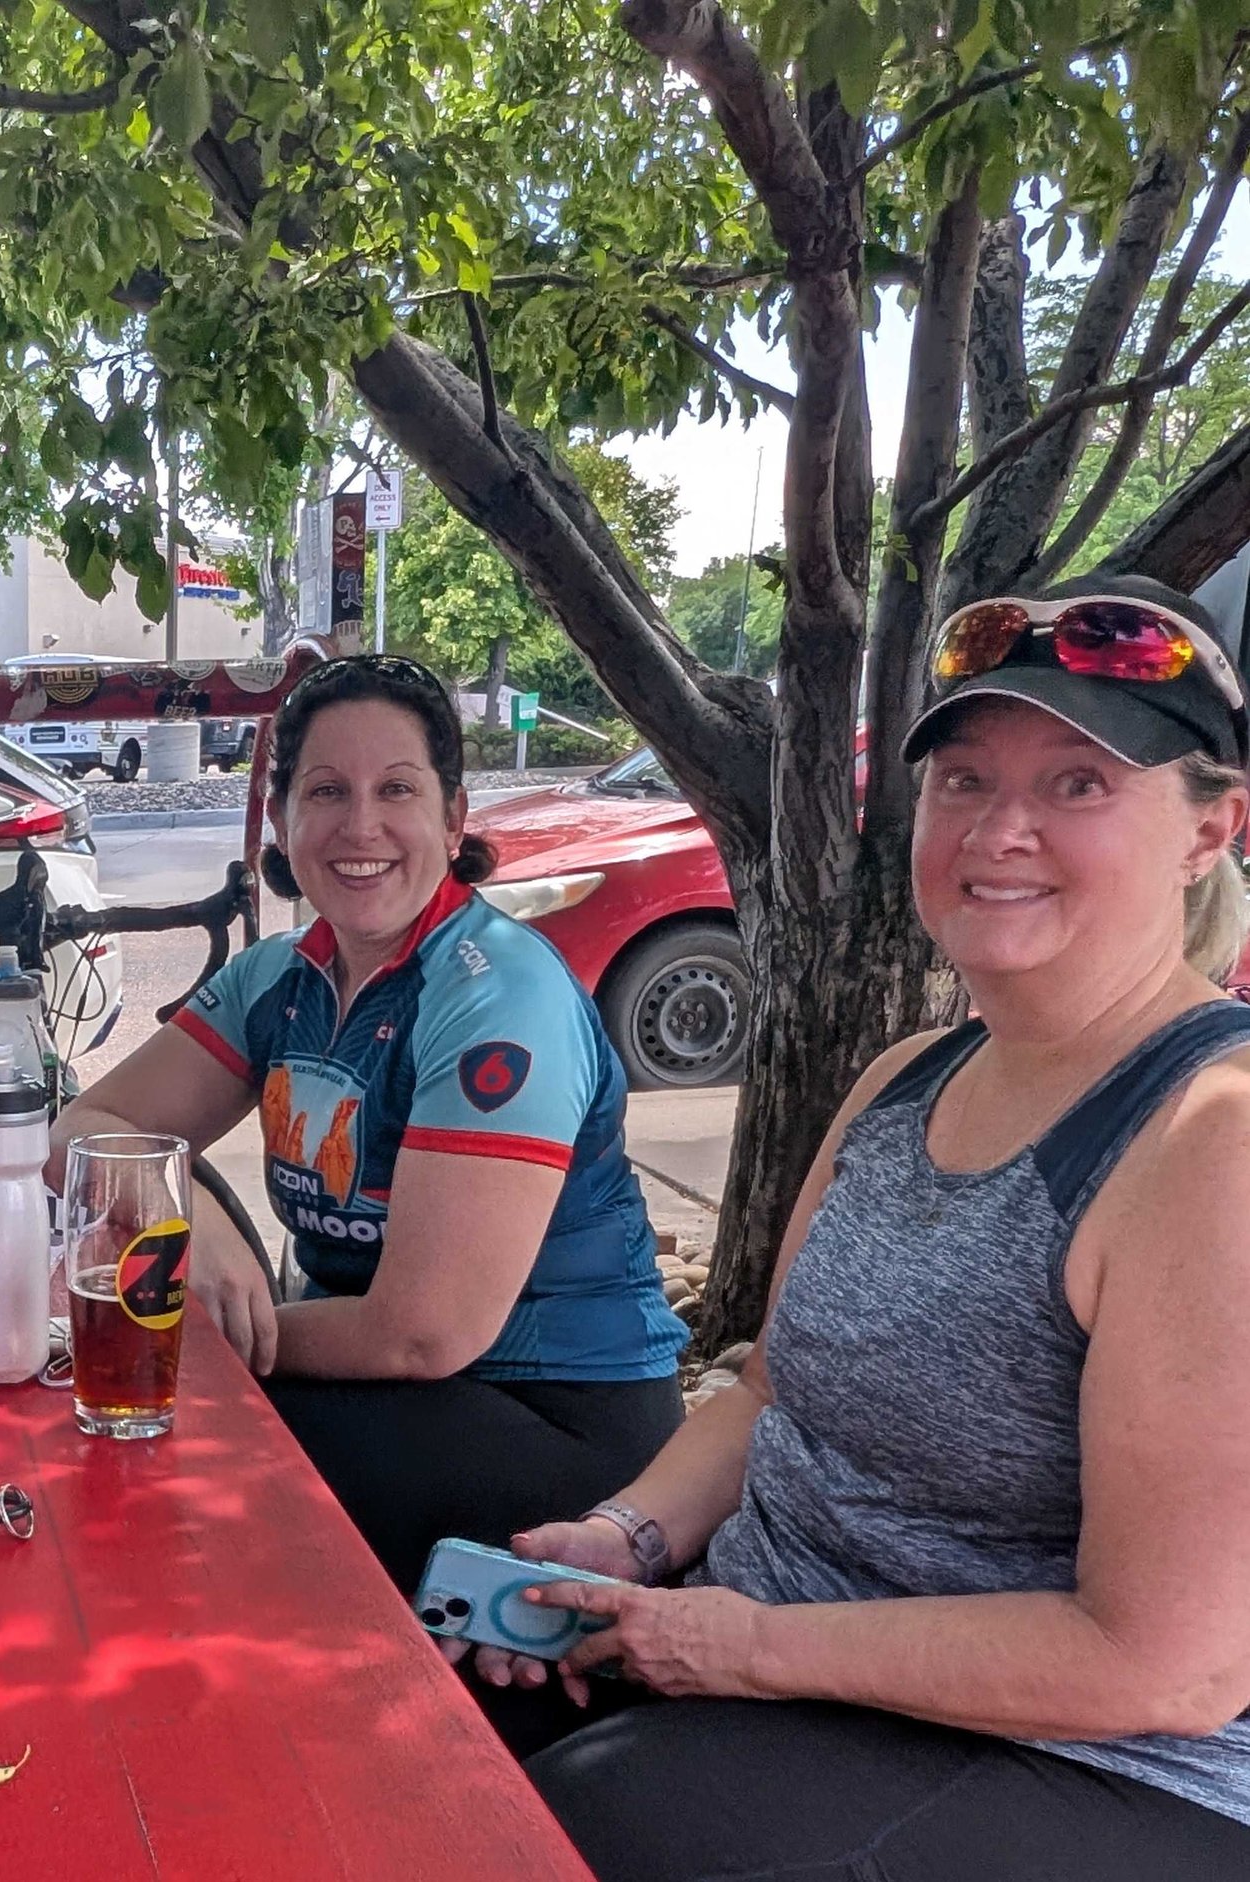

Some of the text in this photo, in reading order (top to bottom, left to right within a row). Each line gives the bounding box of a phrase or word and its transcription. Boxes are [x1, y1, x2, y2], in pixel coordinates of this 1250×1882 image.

[370, 494, 396, 502] ACCESS
[374, 504, 391, 512] ONLY
[164, 704, 196, 718] BEER
[456, 939, 491, 977] CON
[474, 1051, 512, 1094] 6
[297, 1206, 387, 1242] MOO
